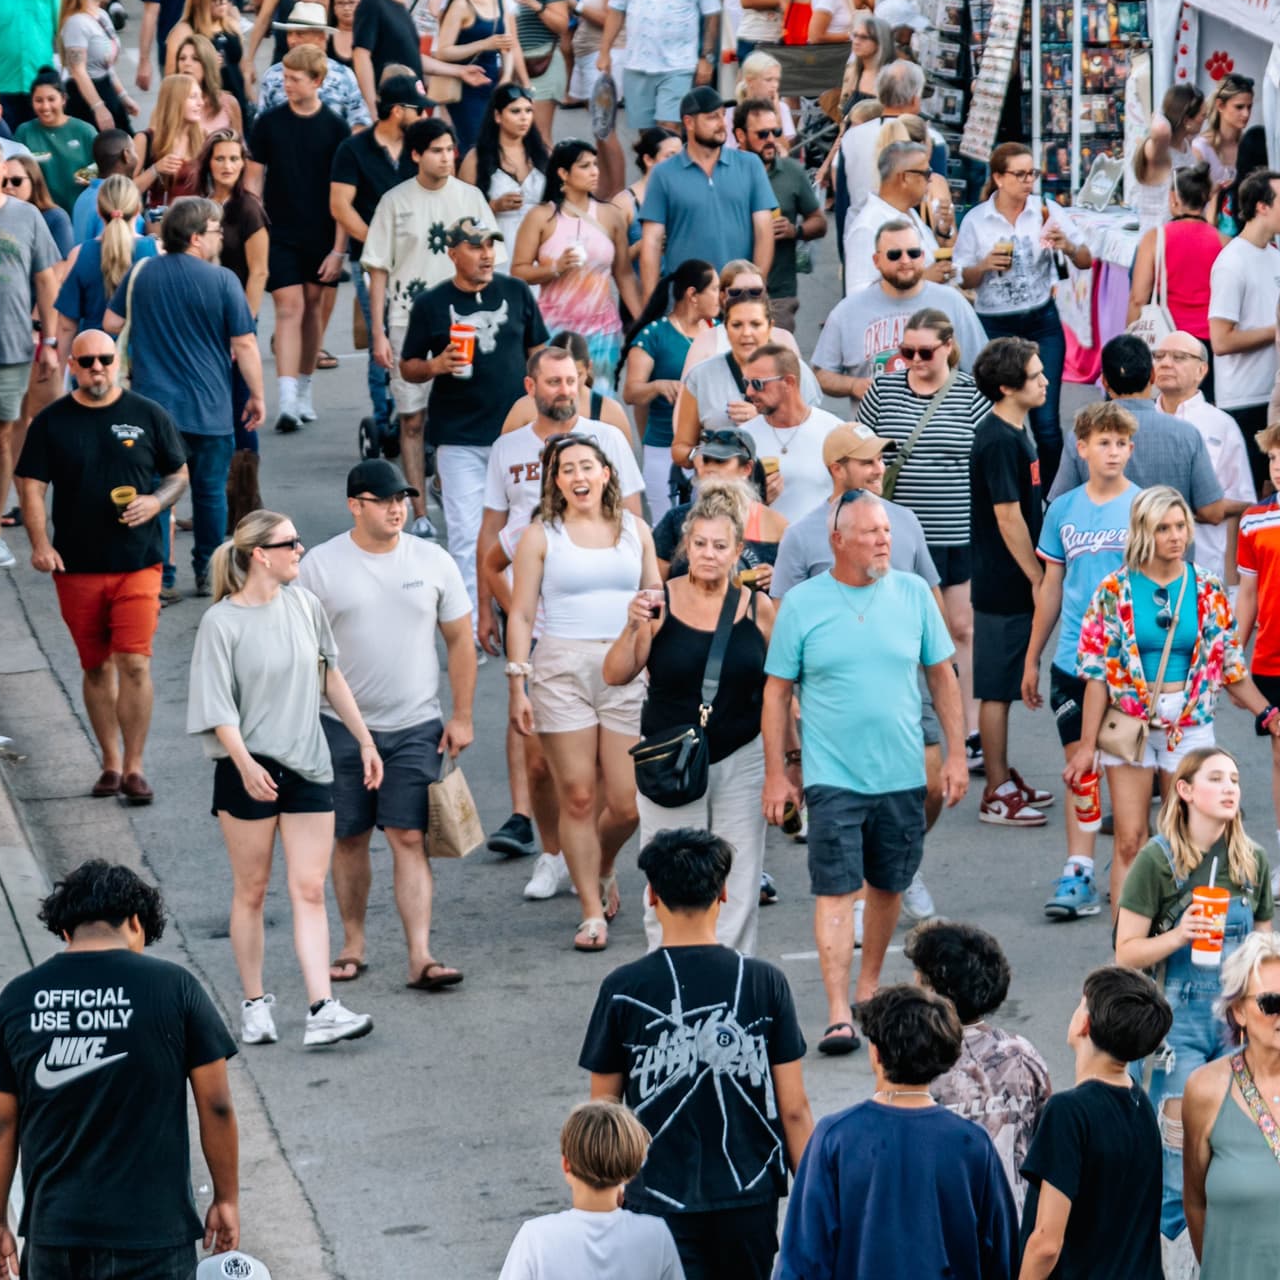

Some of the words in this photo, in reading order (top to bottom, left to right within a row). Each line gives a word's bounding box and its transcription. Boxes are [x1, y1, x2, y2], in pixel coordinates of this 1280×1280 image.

[864, 317, 908, 361] OKLA
[1059, 522, 1128, 558] Ranger
[34, 986, 131, 1010] OFFICIAL
[30, 1010, 71, 1033] USE
[76, 1008, 134, 1031] ONLY
[46, 1036, 108, 1066] NIKE
[720, 1031, 732, 1045] 8
